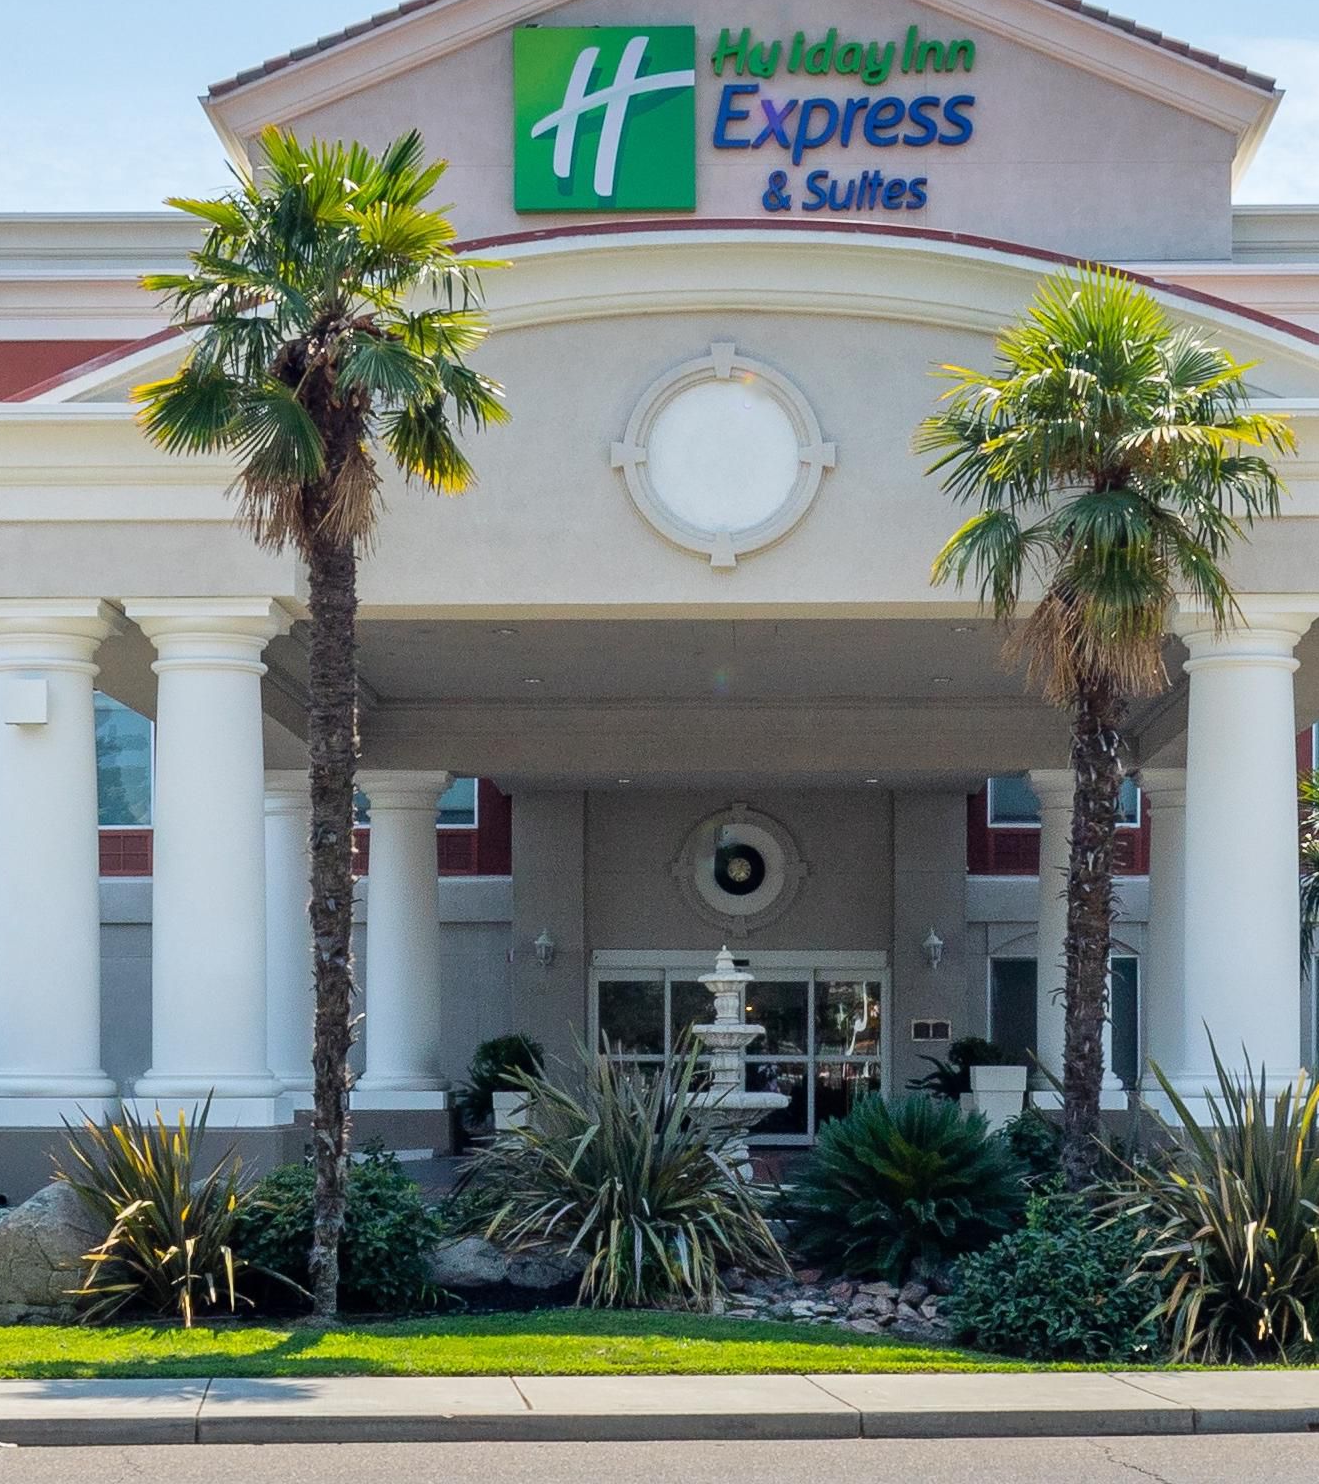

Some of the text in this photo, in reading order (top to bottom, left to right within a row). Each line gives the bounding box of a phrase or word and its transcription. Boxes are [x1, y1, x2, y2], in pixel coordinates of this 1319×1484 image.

[902, 25, 976, 73] Inn
[713, 83, 976, 165] Express
[761, 169, 928, 212] & Suites
